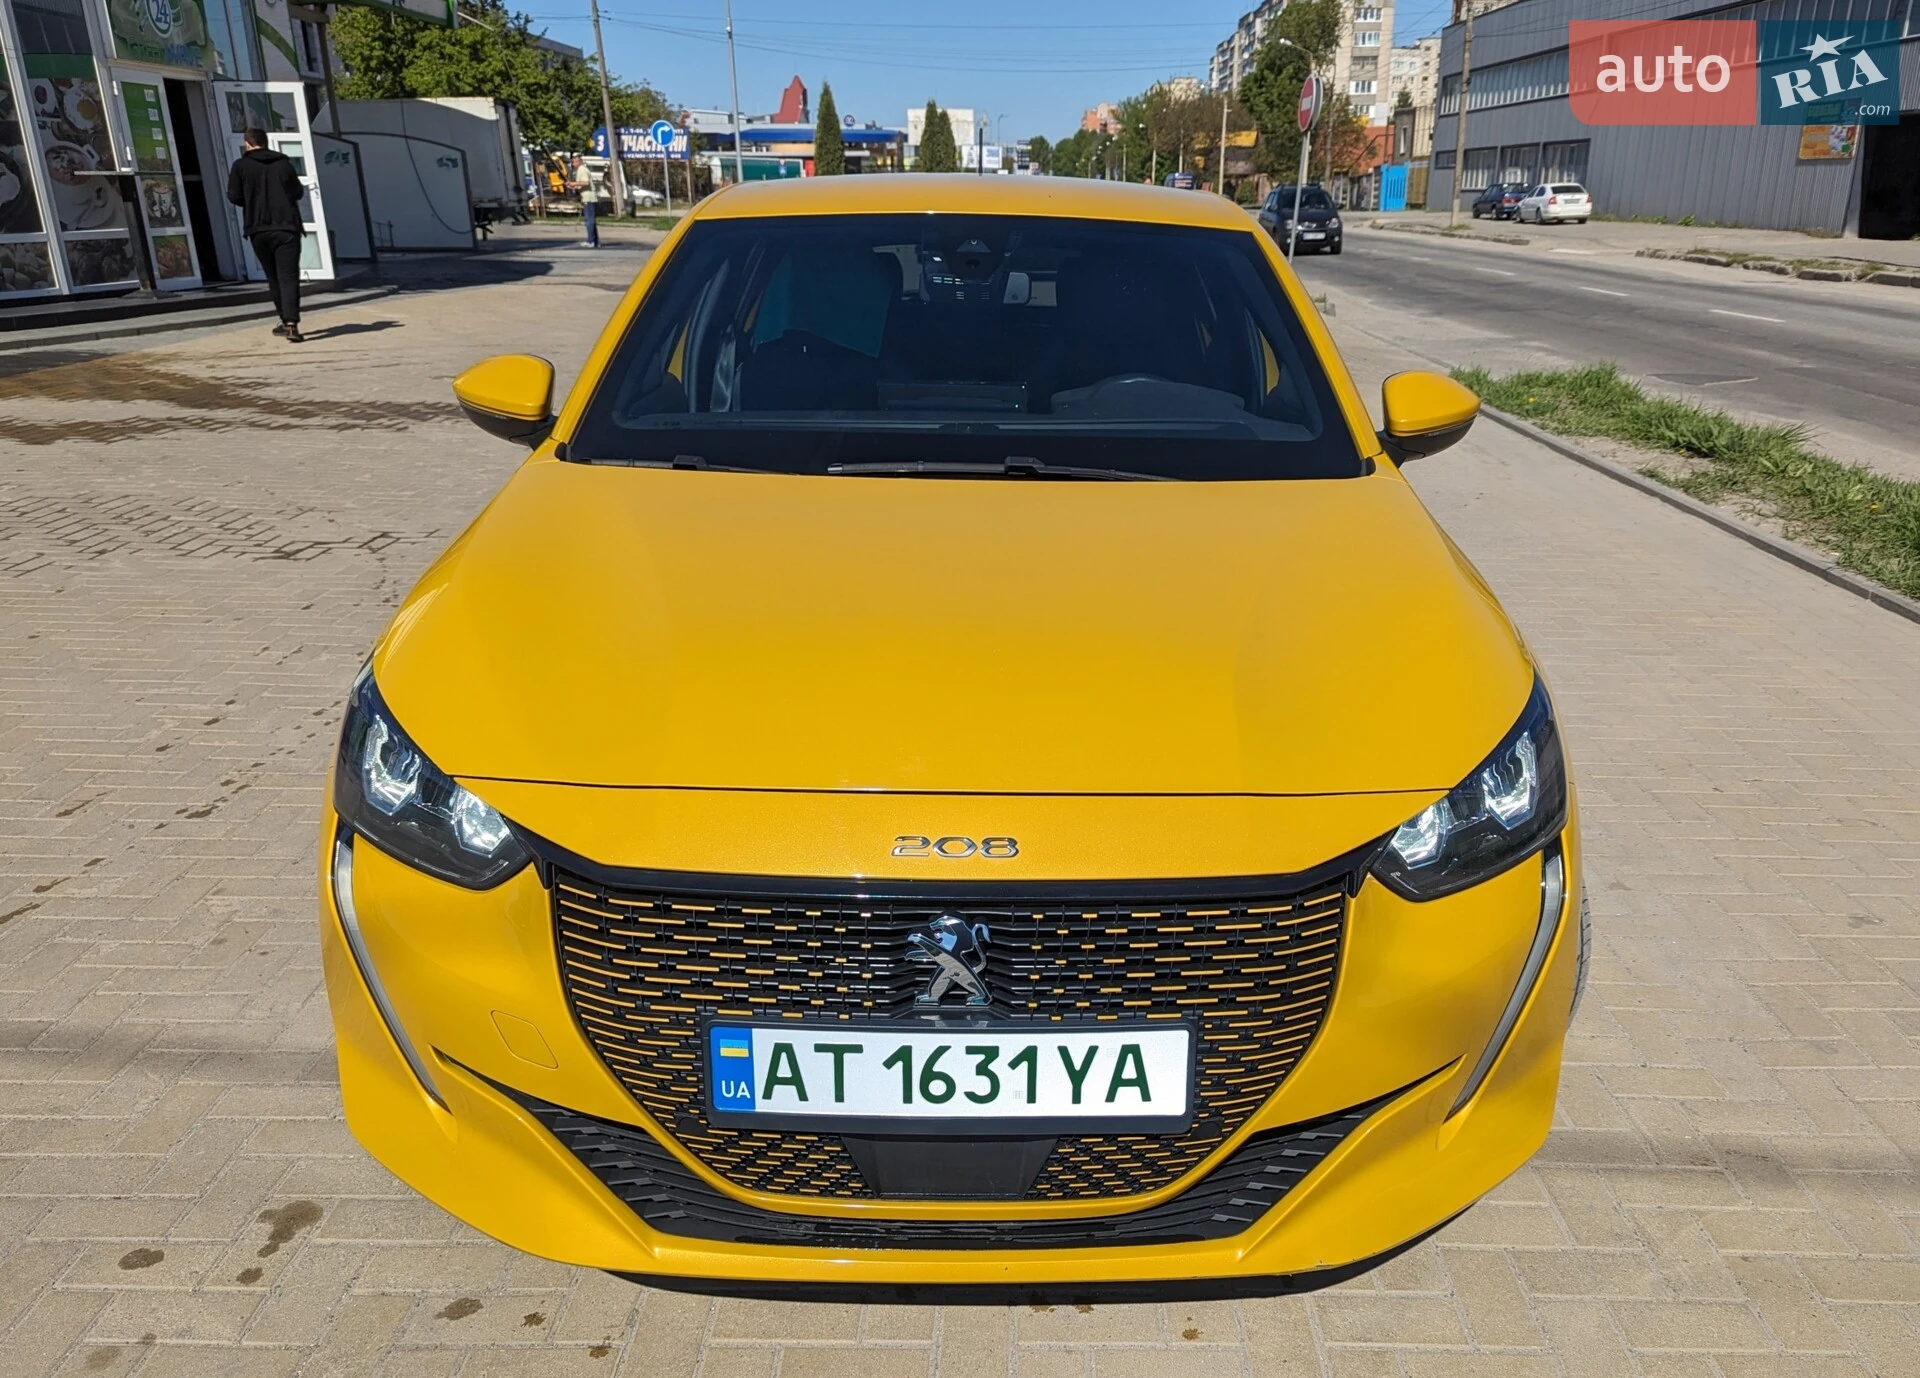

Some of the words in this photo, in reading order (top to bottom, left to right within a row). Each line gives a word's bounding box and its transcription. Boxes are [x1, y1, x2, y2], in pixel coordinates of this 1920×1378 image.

[152, 0, 170, 24] 24
[891, 835, 1020, 858] 208
[762, 1042, 863, 1103] AT
[882, 1044, 1038, 1104] 1631
[1057, 1044, 1152, 1104] YA
[722, 1080, 751, 1099] UA
